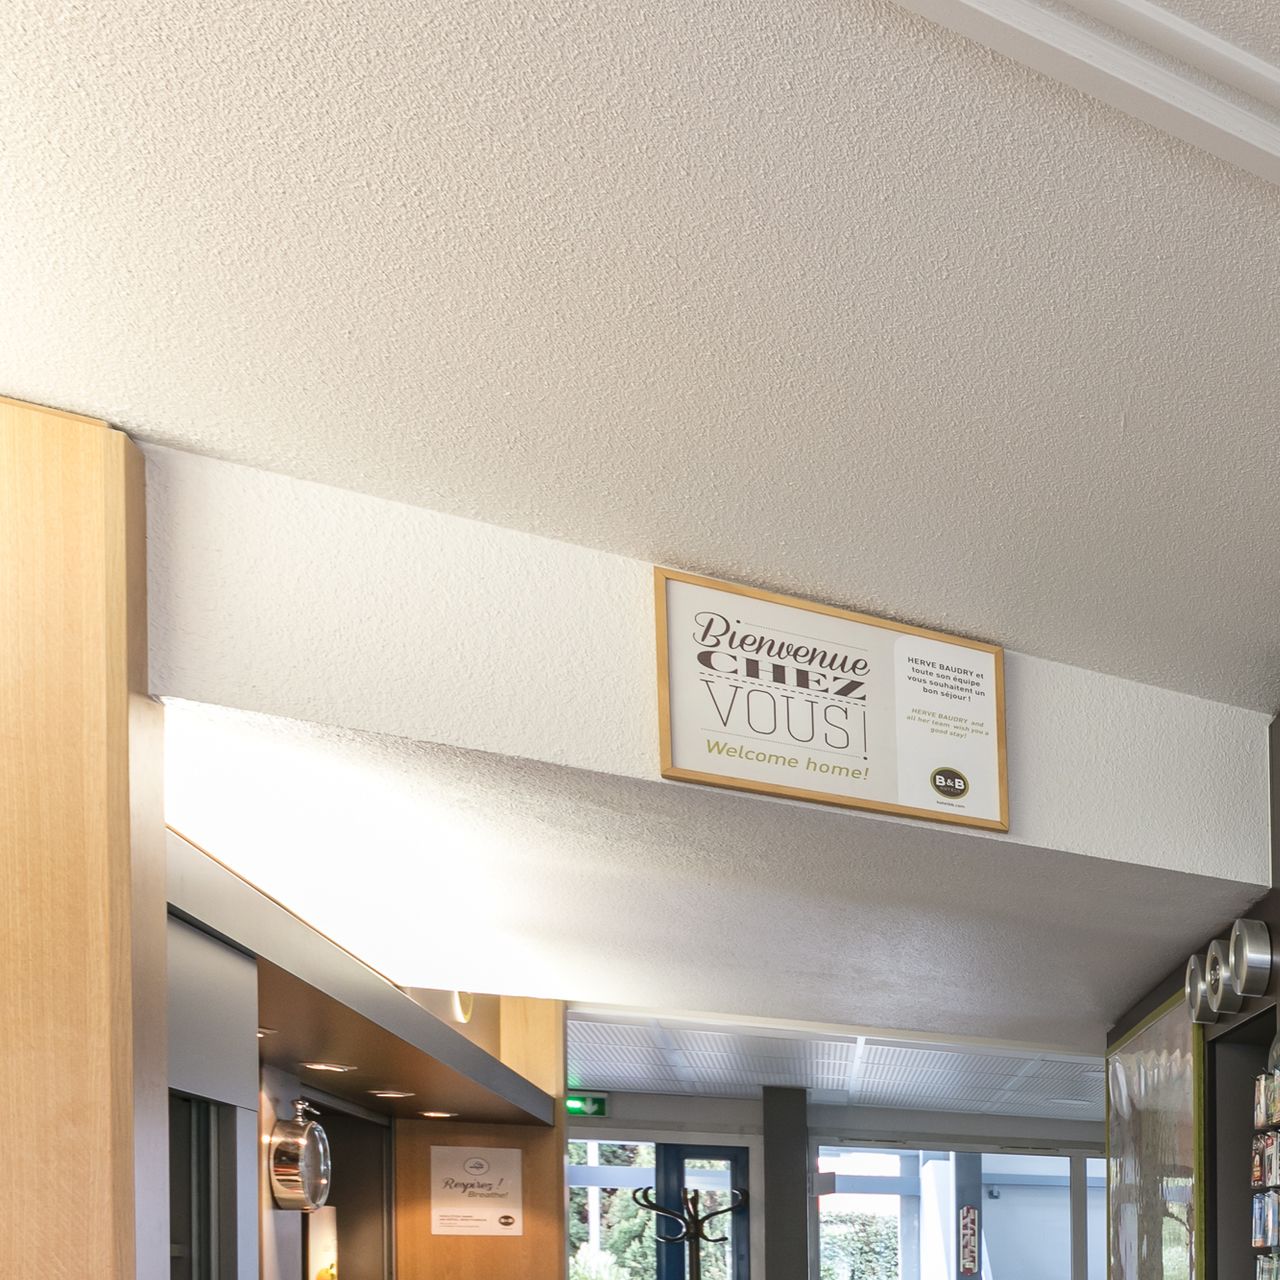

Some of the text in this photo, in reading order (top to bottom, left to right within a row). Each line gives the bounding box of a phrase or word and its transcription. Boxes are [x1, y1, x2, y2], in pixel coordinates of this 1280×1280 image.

[692, 611, 871, 676] Bienvenue
[697, 650, 867, 701] CHEZ
[907, 656, 937, 669] HERVE
[939, 663, 974, 677] BAUDRY
[911, 666, 981, 687] toute son équipe
[907, 675, 927, 684] vous
[928, 679, 973, 694] souhaitent
[922, 686, 967, 701] bon séjour
[911, 708, 937, 718] HERVE
[938, 713, 968, 724] BAUDRY
[706, 739, 870, 781] Welcome home!
[935, 775, 965, 790] B&B
